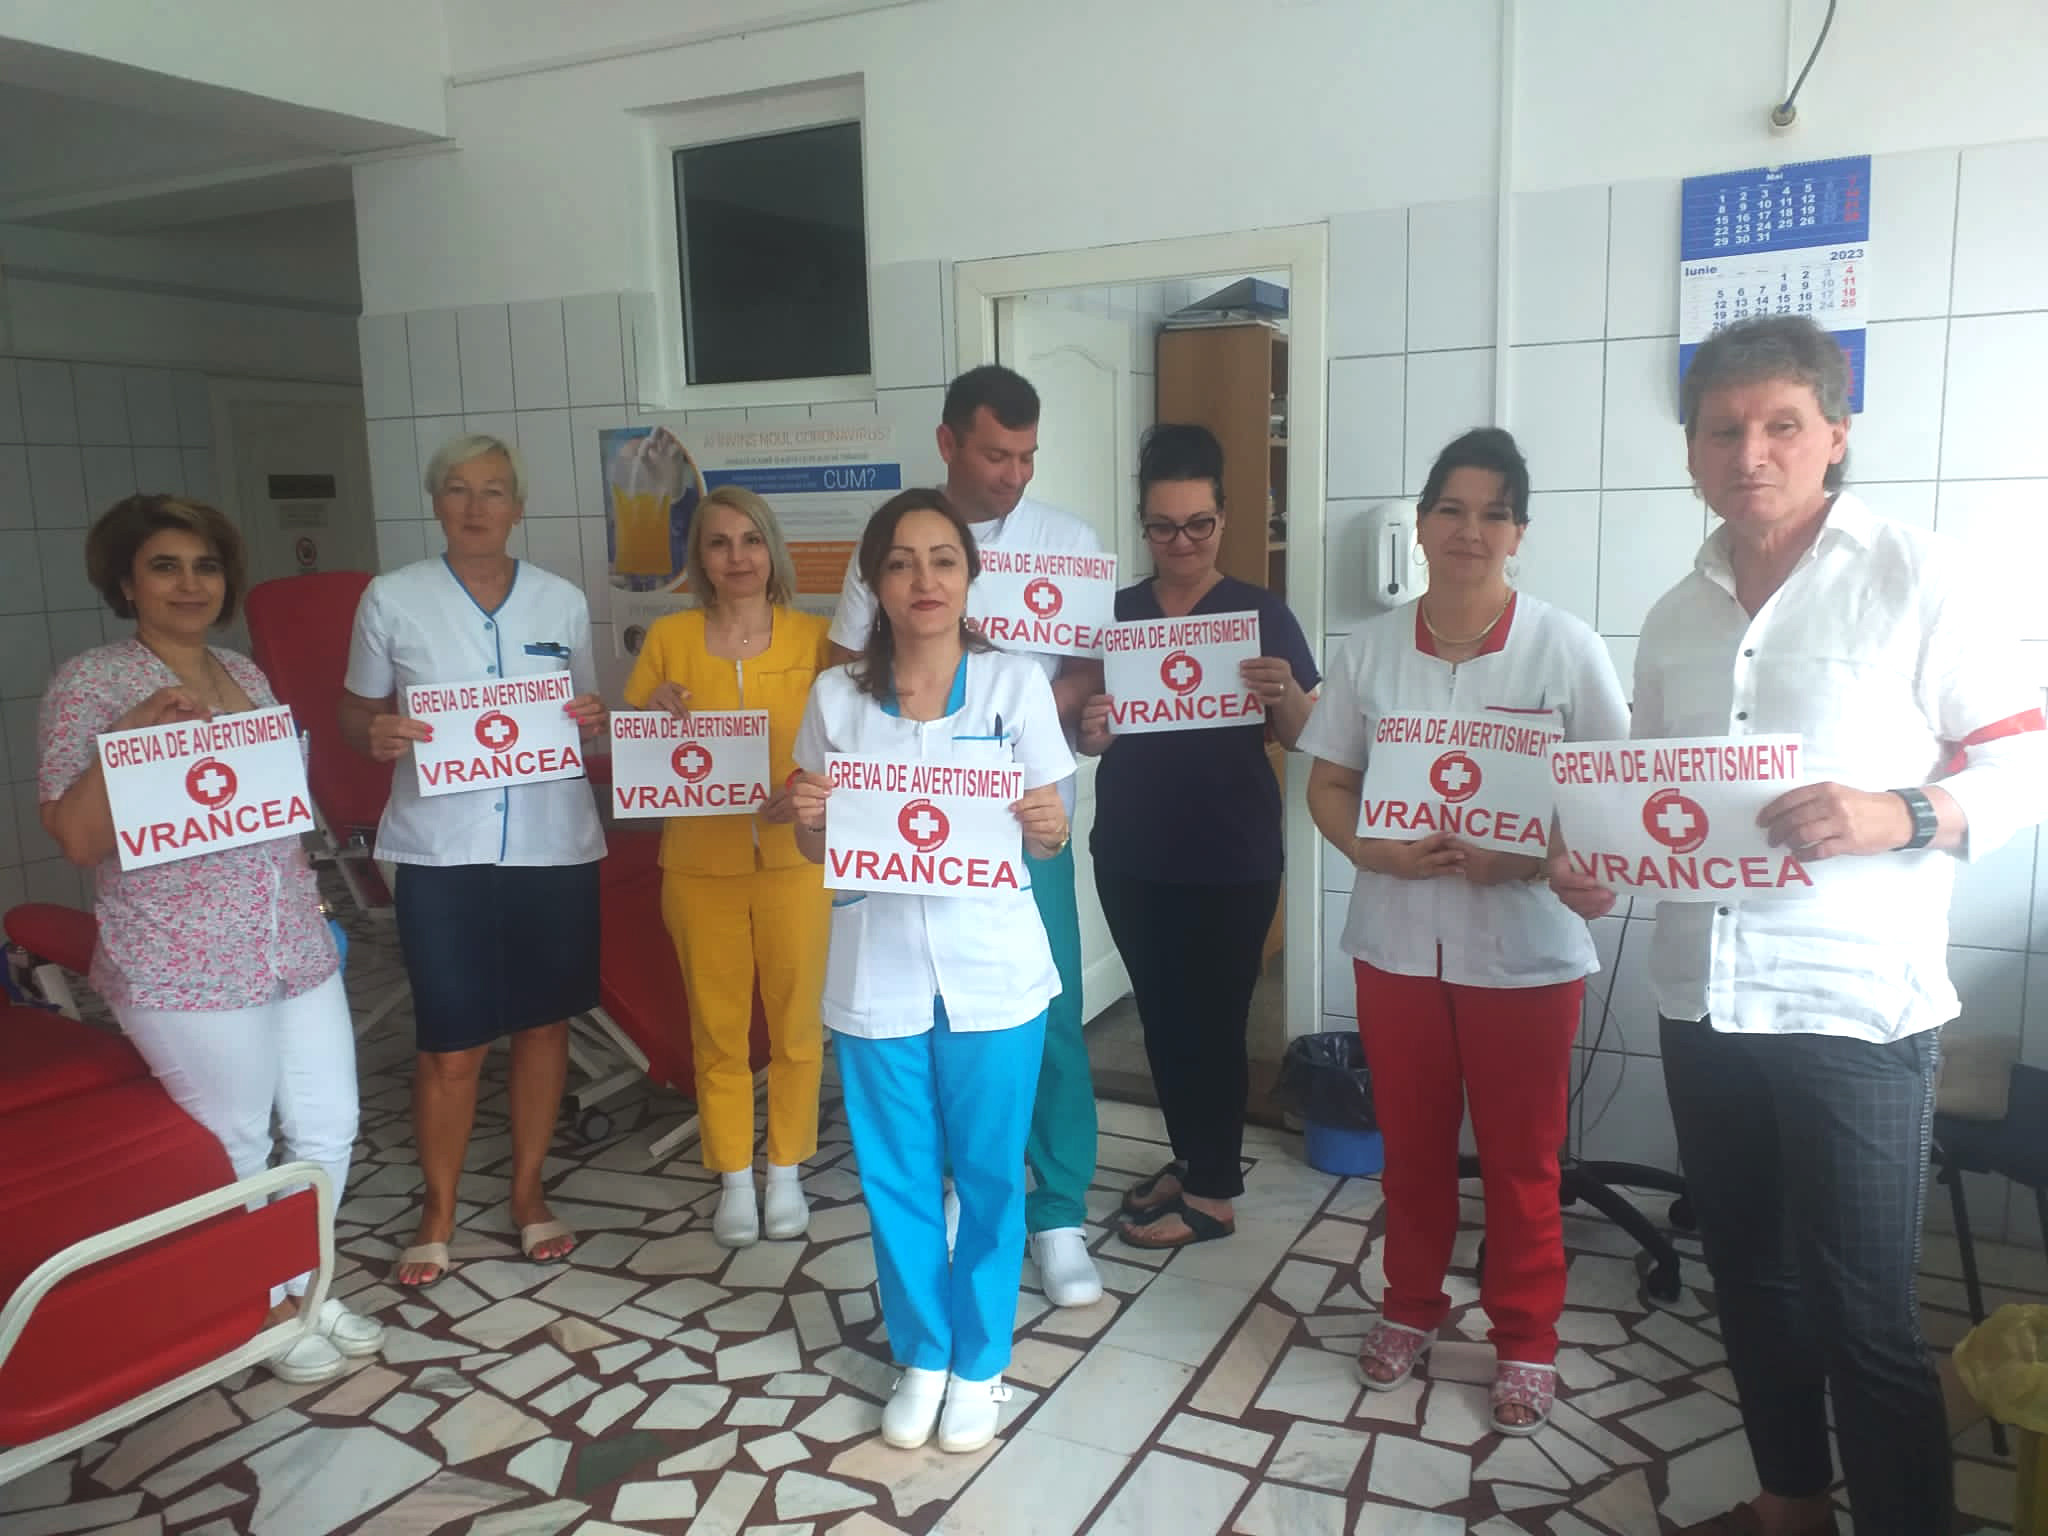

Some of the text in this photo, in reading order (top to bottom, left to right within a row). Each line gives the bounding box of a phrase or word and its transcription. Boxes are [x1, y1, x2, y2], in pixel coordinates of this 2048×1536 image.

[1739, 202, 1747, 211] 9
[1759, 200, 1772, 209] 10
[1780, 198, 1792, 206] 11
[1801, 194, 1816, 203] 12
[1740, 192, 1747, 200] 2
[1761, 190, 1768, 198] 3
[1782, 186, 1790, 195] 4
[1804, 184, 1812, 192] 5
[1714, 216, 1728, 224] 15
[1736, 214, 1750, 222] 16
[1758, 211, 1772, 220] 17
[1779, 208, 1793, 217] 18
[1800, 206, 1816, 214] 19
[1714, 226, 1728, 236] 22
[1735, 224, 1750, 233] 23
[1756, 222, 1772, 231] 24
[1777, 220, 1793, 228] 25
[1800, 216, 1816, 226] 26
[1714, 232, 1770, 246] 29 30 31
[1830, 249, 1864, 261] 2023
[1685, 266, 1718, 277] Iunie
[1802, 271, 1809, 280] 2
[1846, 266, 1854, 274] 4
[1714, 301, 1727, 310] 12
[1736, 298, 1748, 308] 13
[1756, 296, 1768, 305] 14
[1778, 294, 1790, 303] 15
[1800, 292, 1812, 301] 16
[1717, 290, 1724, 298] 5
[1738, 288, 1744, 296] 6
[1759, 286, 1766, 294] 7
[1780, 284, 1788, 292] 8
[1802, 282, 1809, 290] 9
[1844, 276, 1856, 286] 11
[1714, 312, 1727, 320] 19
[1734, 310, 1748, 318] 20
[1755, 307, 1768, 316] 21
[1776, 305, 1790, 314] 22
[1798, 303, 1812, 312] 23
[823, 467, 877, 489] CUM?
[978, 550, 1116, 581] REVA DE AVERTISMENT
[1104, 617, 1257, 652] GREVA DE AVERTISMENT
[411, 676, 572, 714] GREVA DE AVERTISMENT
[1109, 692, 1263, 726] VRANCEA
[104, 734, 165, 768] GREVA
[164, 730, 190, 759] DE
[193, 712, 294, 753] AVERTISMENT
[614, 716, 768, 739] GREVA DE AVERTISMENT
[1376, 717, 1422, 744] GREVA
[1424, 718, 1448, 745] DE
[420, 746, 581, 786] VRANCEA
[1552, 744, 1798, 785] GREVA DE AVERTISMENT
[829, 760, 1022, 800] GREVA DE AVERTISMENT
[616, 782, 769, 810] VRANCEA
[120, 796, 311, 857] VRANCEA
[1364, 800, 1546, 848] VRANCEA
[828, 848, 1019, 889] VRANCEA
[1571, 850, 1814, 890] VRANCEA
